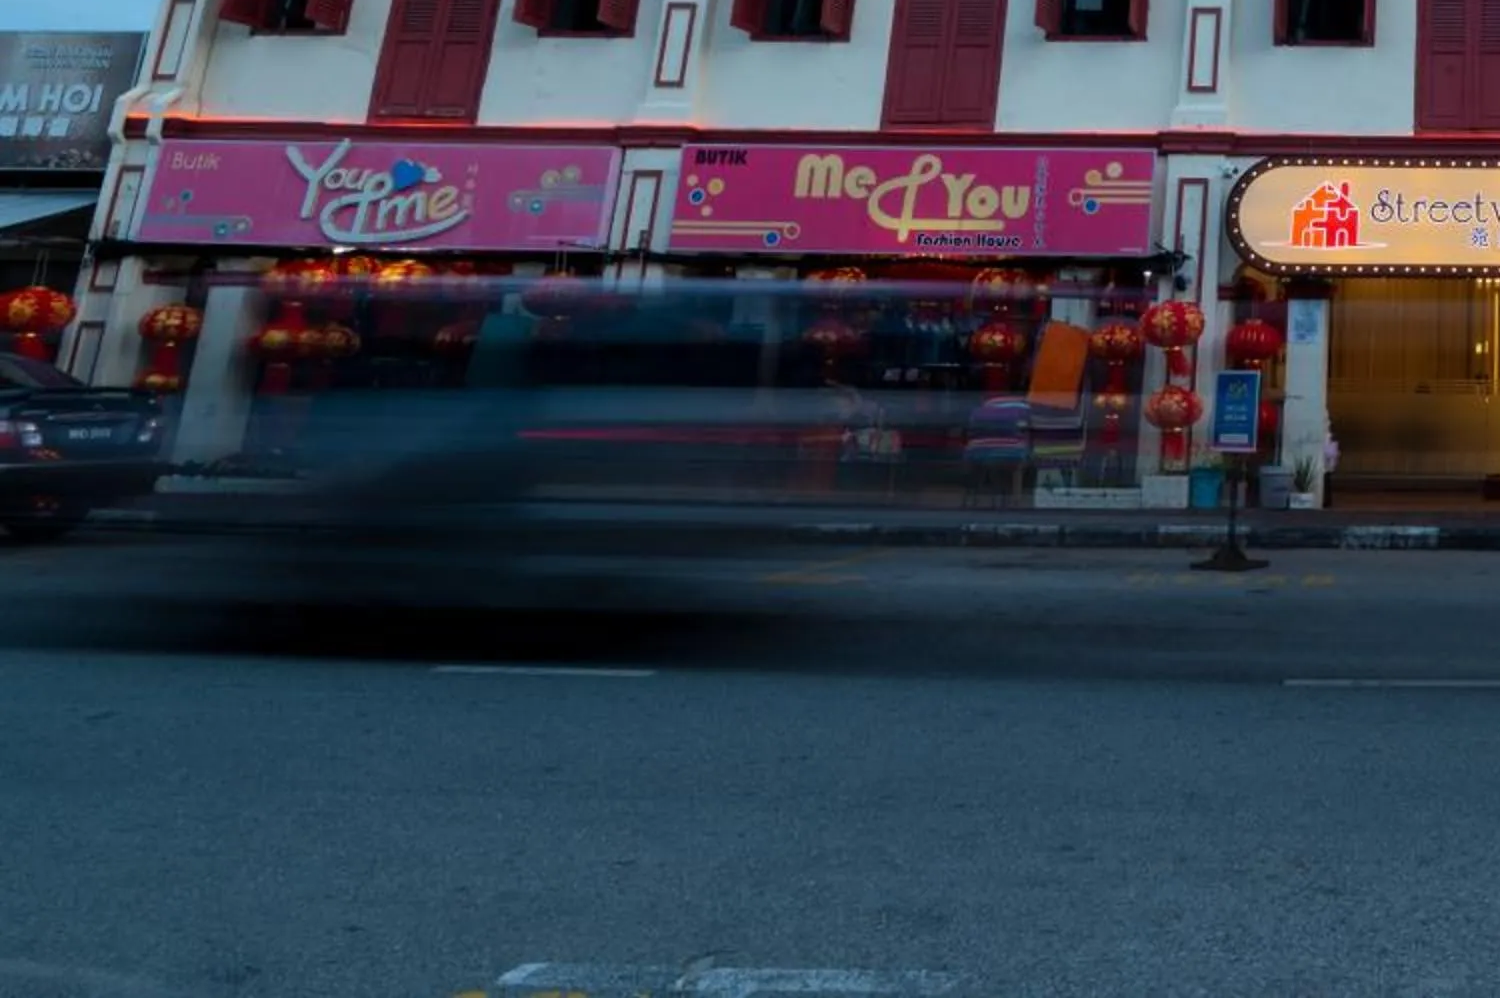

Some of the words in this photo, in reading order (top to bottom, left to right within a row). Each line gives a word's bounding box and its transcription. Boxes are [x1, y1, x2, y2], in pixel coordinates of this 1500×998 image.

[38, 83, 104, 113] HOI
[171, 150, 221, 171] Butik
[695, 150, 748, 166] BUTIK
[286, 138, 373, 219] You
[375, 185, 459, 230] me
[794, 154, 877, 199] Me
[940, 174, 1031, 219] You
[917, 233, 971, 247] Fashion
[976, 233, 1021, 247] House
